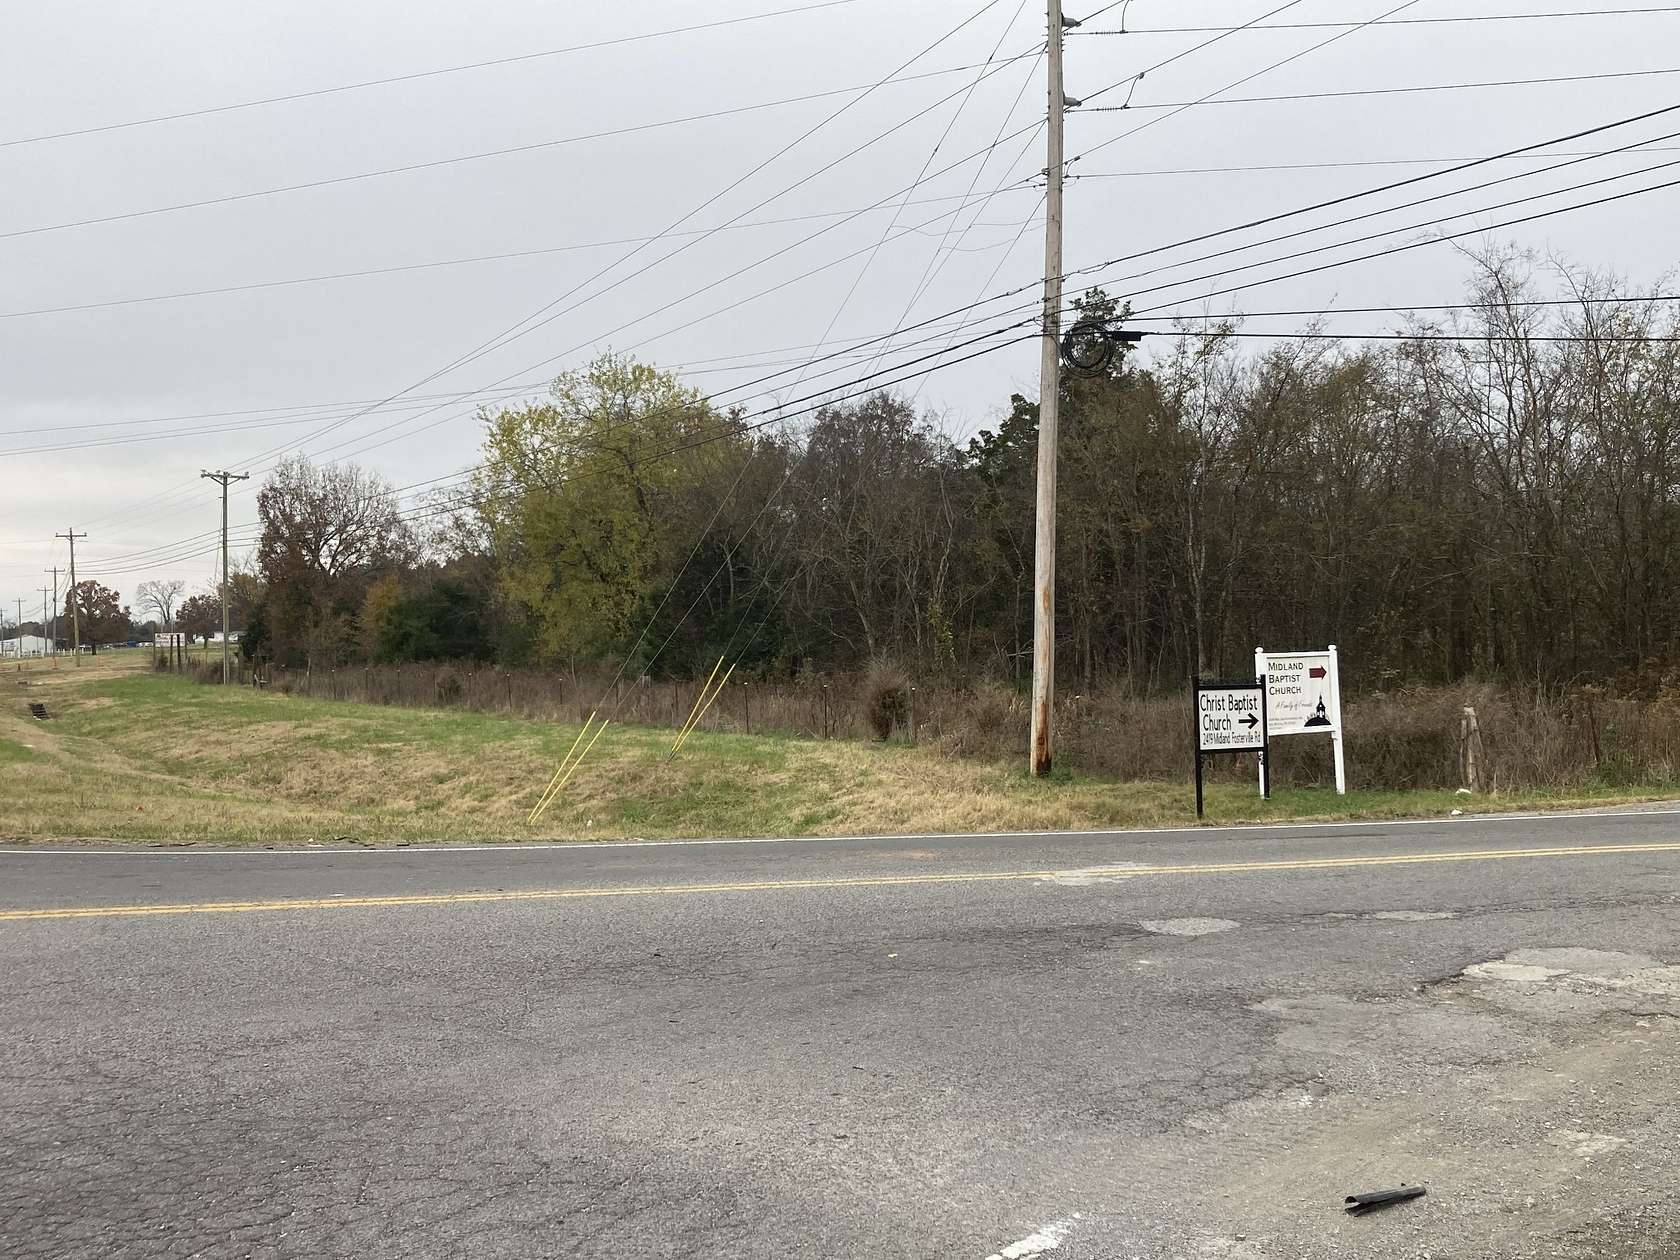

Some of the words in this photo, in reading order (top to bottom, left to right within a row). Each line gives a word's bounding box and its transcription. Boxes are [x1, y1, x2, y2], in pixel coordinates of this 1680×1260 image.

[1268, 662, 1304, 671] MIDLAND
[1268, 674, 1301, 683] BAPTIST
[1269, 686, 1302, 695] CHURCH
[1200, 694, 1225, 711] Christ
[1228, 694, 1257, 714] Baptist
[1203, 713, 1231, 731] Church
[1213, 732, 1230, 744] Midland
